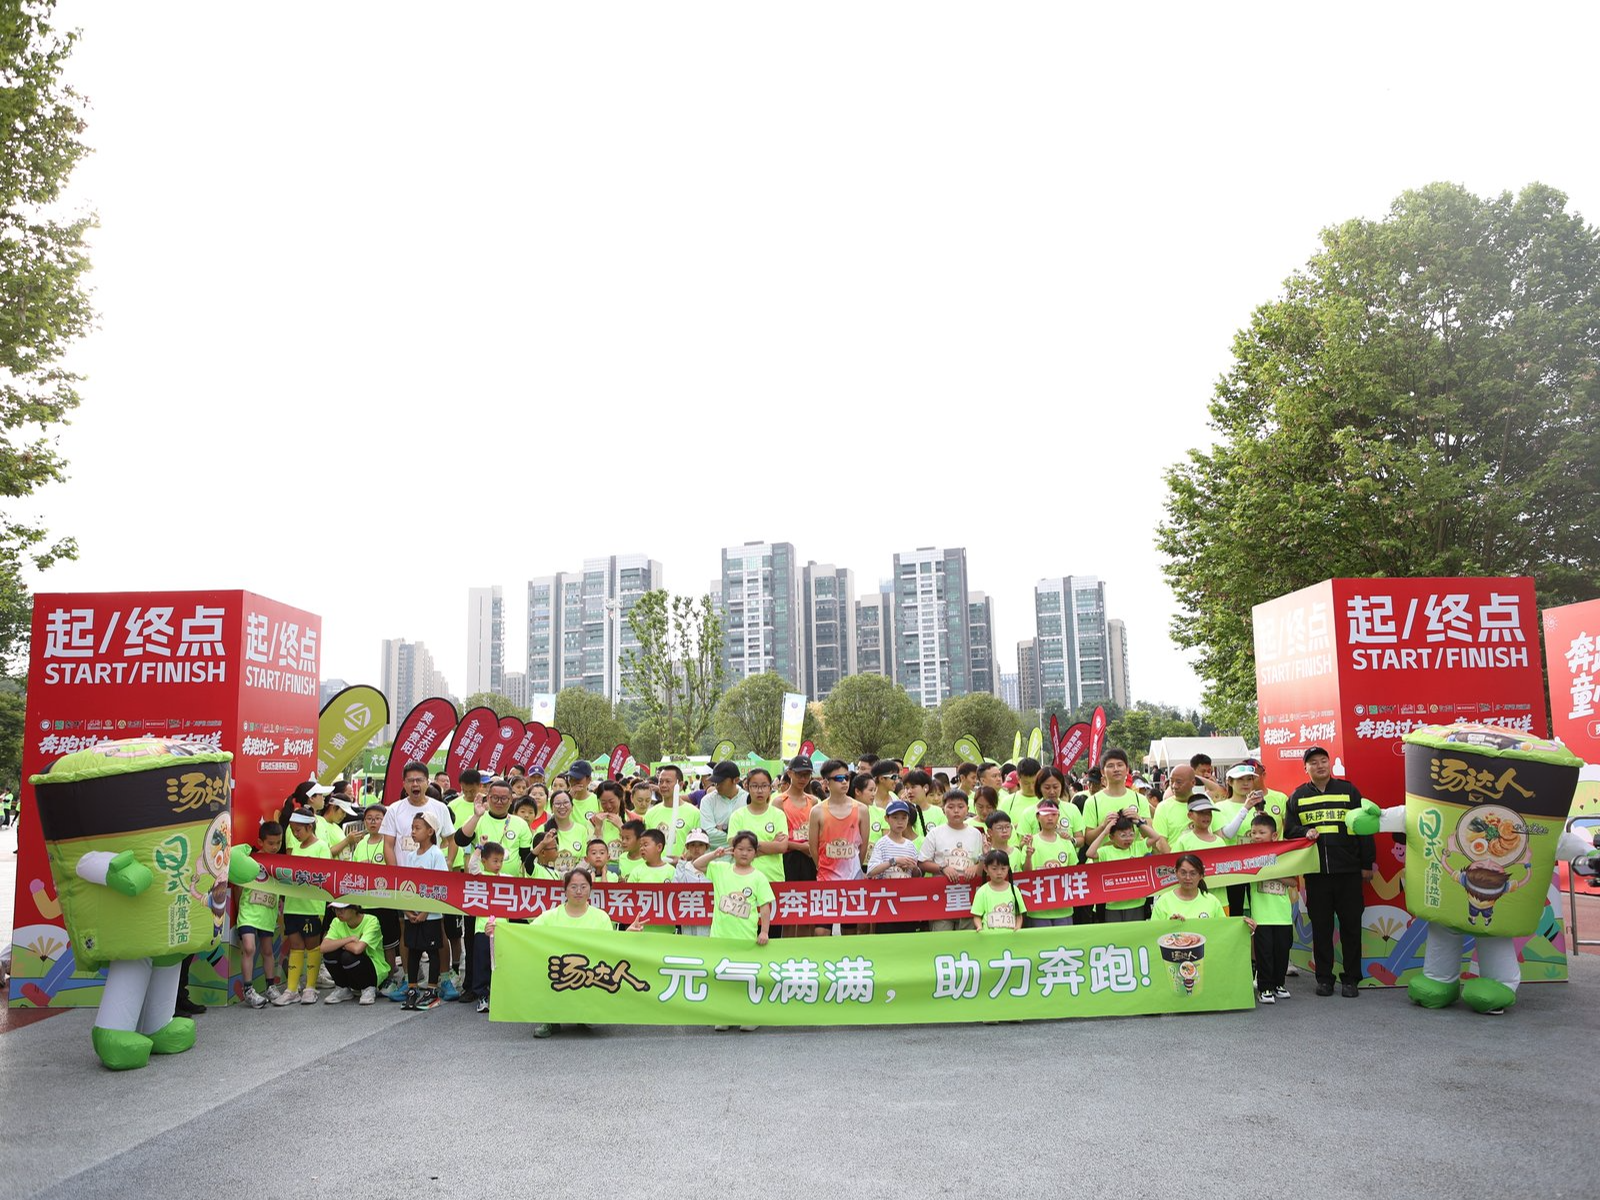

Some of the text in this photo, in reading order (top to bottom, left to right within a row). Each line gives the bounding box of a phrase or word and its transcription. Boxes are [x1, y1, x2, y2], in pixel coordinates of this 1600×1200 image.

[44, 605, 226, 659] 起/终点
[1347, 592, 1526, 645] 起/终点
[245, 612, 317, 674] 起/终点
[1260, 654, 1332, 685] START/FINISH
[1352, 646, 1529, 670] START/FINISH
[45, 661, 226, 685] START/FINISH
[245, 666, 317, 697] START/FINISH
[242, 734, 314, 758] 奔跑过六一 童心不打烊
[400, 711, 435, 755] 爽爽贵阳
[1430, 758, 1536, 799] 汤达人
[1304, 810, 1346, 822] 秩序维护
[828, 846, 853, 856] 1-570
[295, 868, 326, 890] 蒙牛
[419, 892, 448, 901] GUSTO
[723, 899, 748, 915] 1-771
[990, 915, 1015, 924] 1-731
[547, 953, 651, 994] 汤达人
[657, 955, 897, 1005] 元气满满，
[932, 943, 1152, 1001] 助力奔跑!
